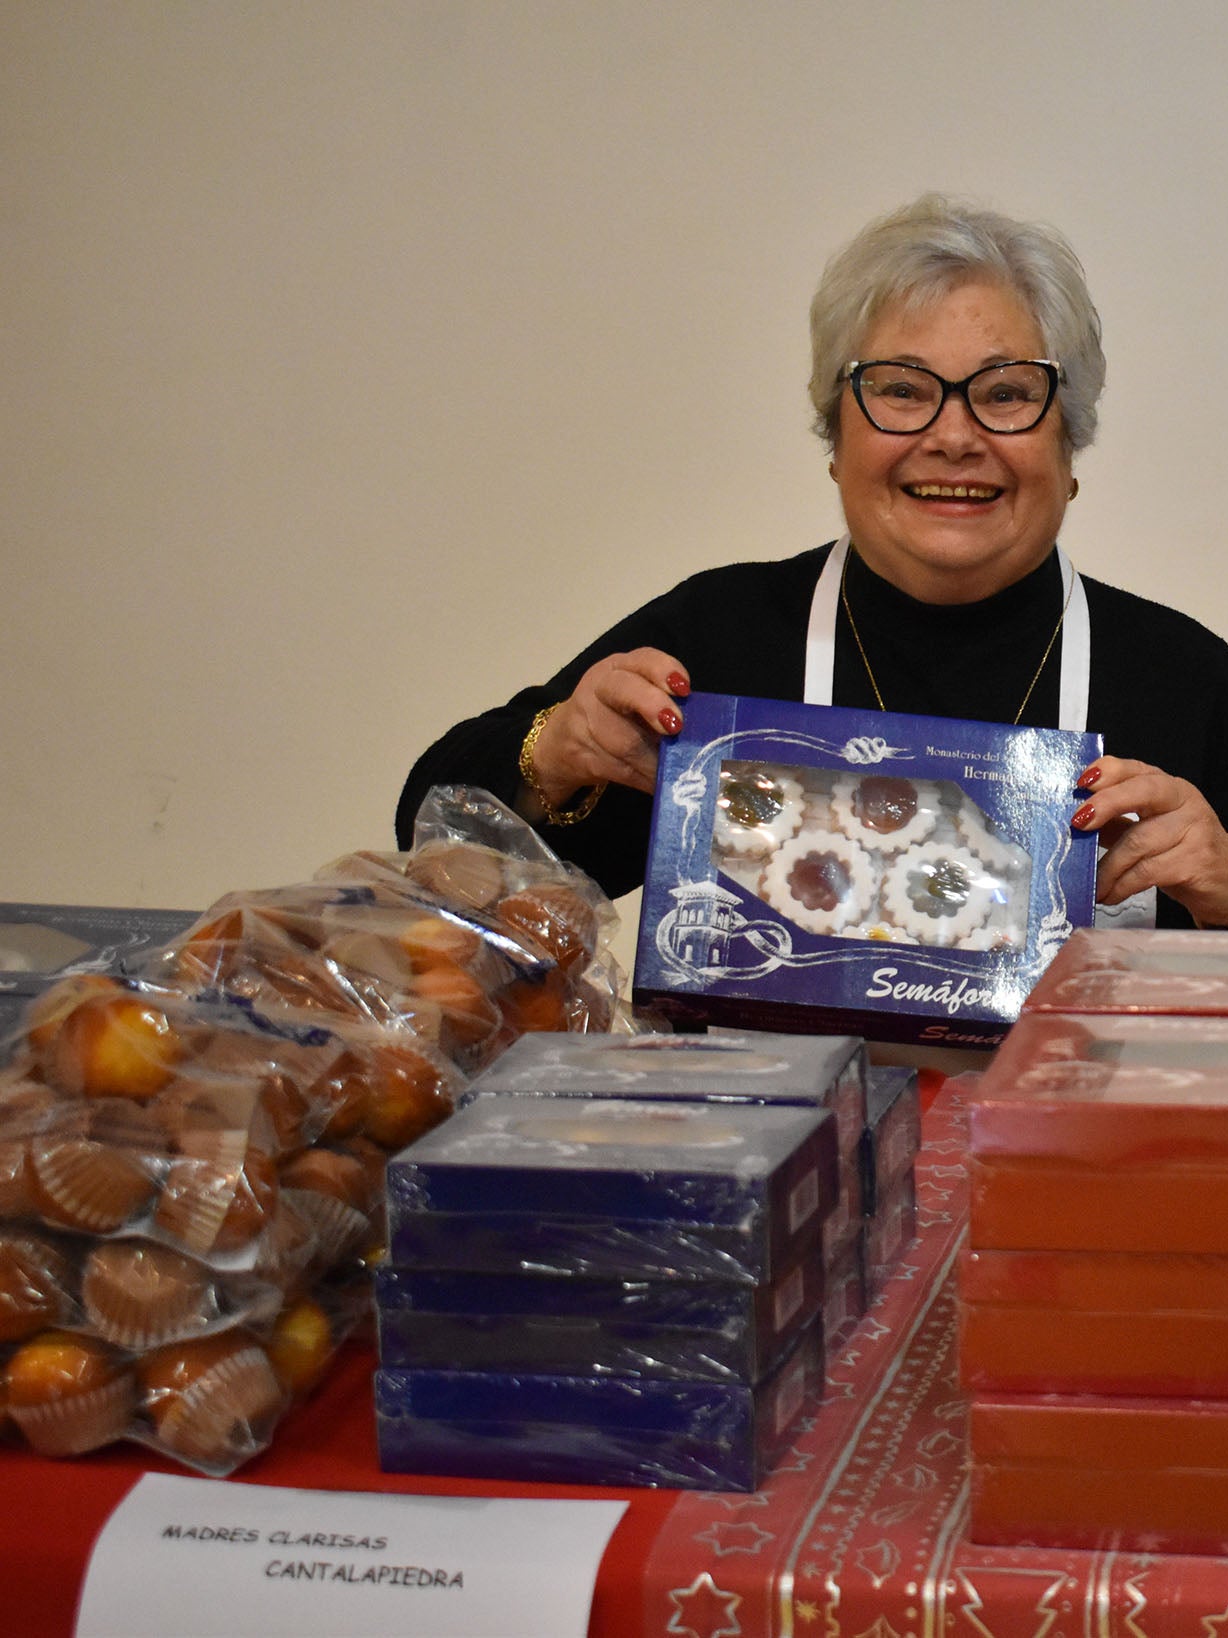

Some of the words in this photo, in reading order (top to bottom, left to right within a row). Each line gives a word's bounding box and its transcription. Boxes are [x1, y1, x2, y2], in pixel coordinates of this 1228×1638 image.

[925, 745, 982, 761] Monasterio
[918, 1025, 1004, 1045] Semá
[161, 1524, 261, 1544] MADRES
[267, 1530, 389, 1551] CLARISAS
[263, 1558, 465, 1590] CANTALAPIEDRA
